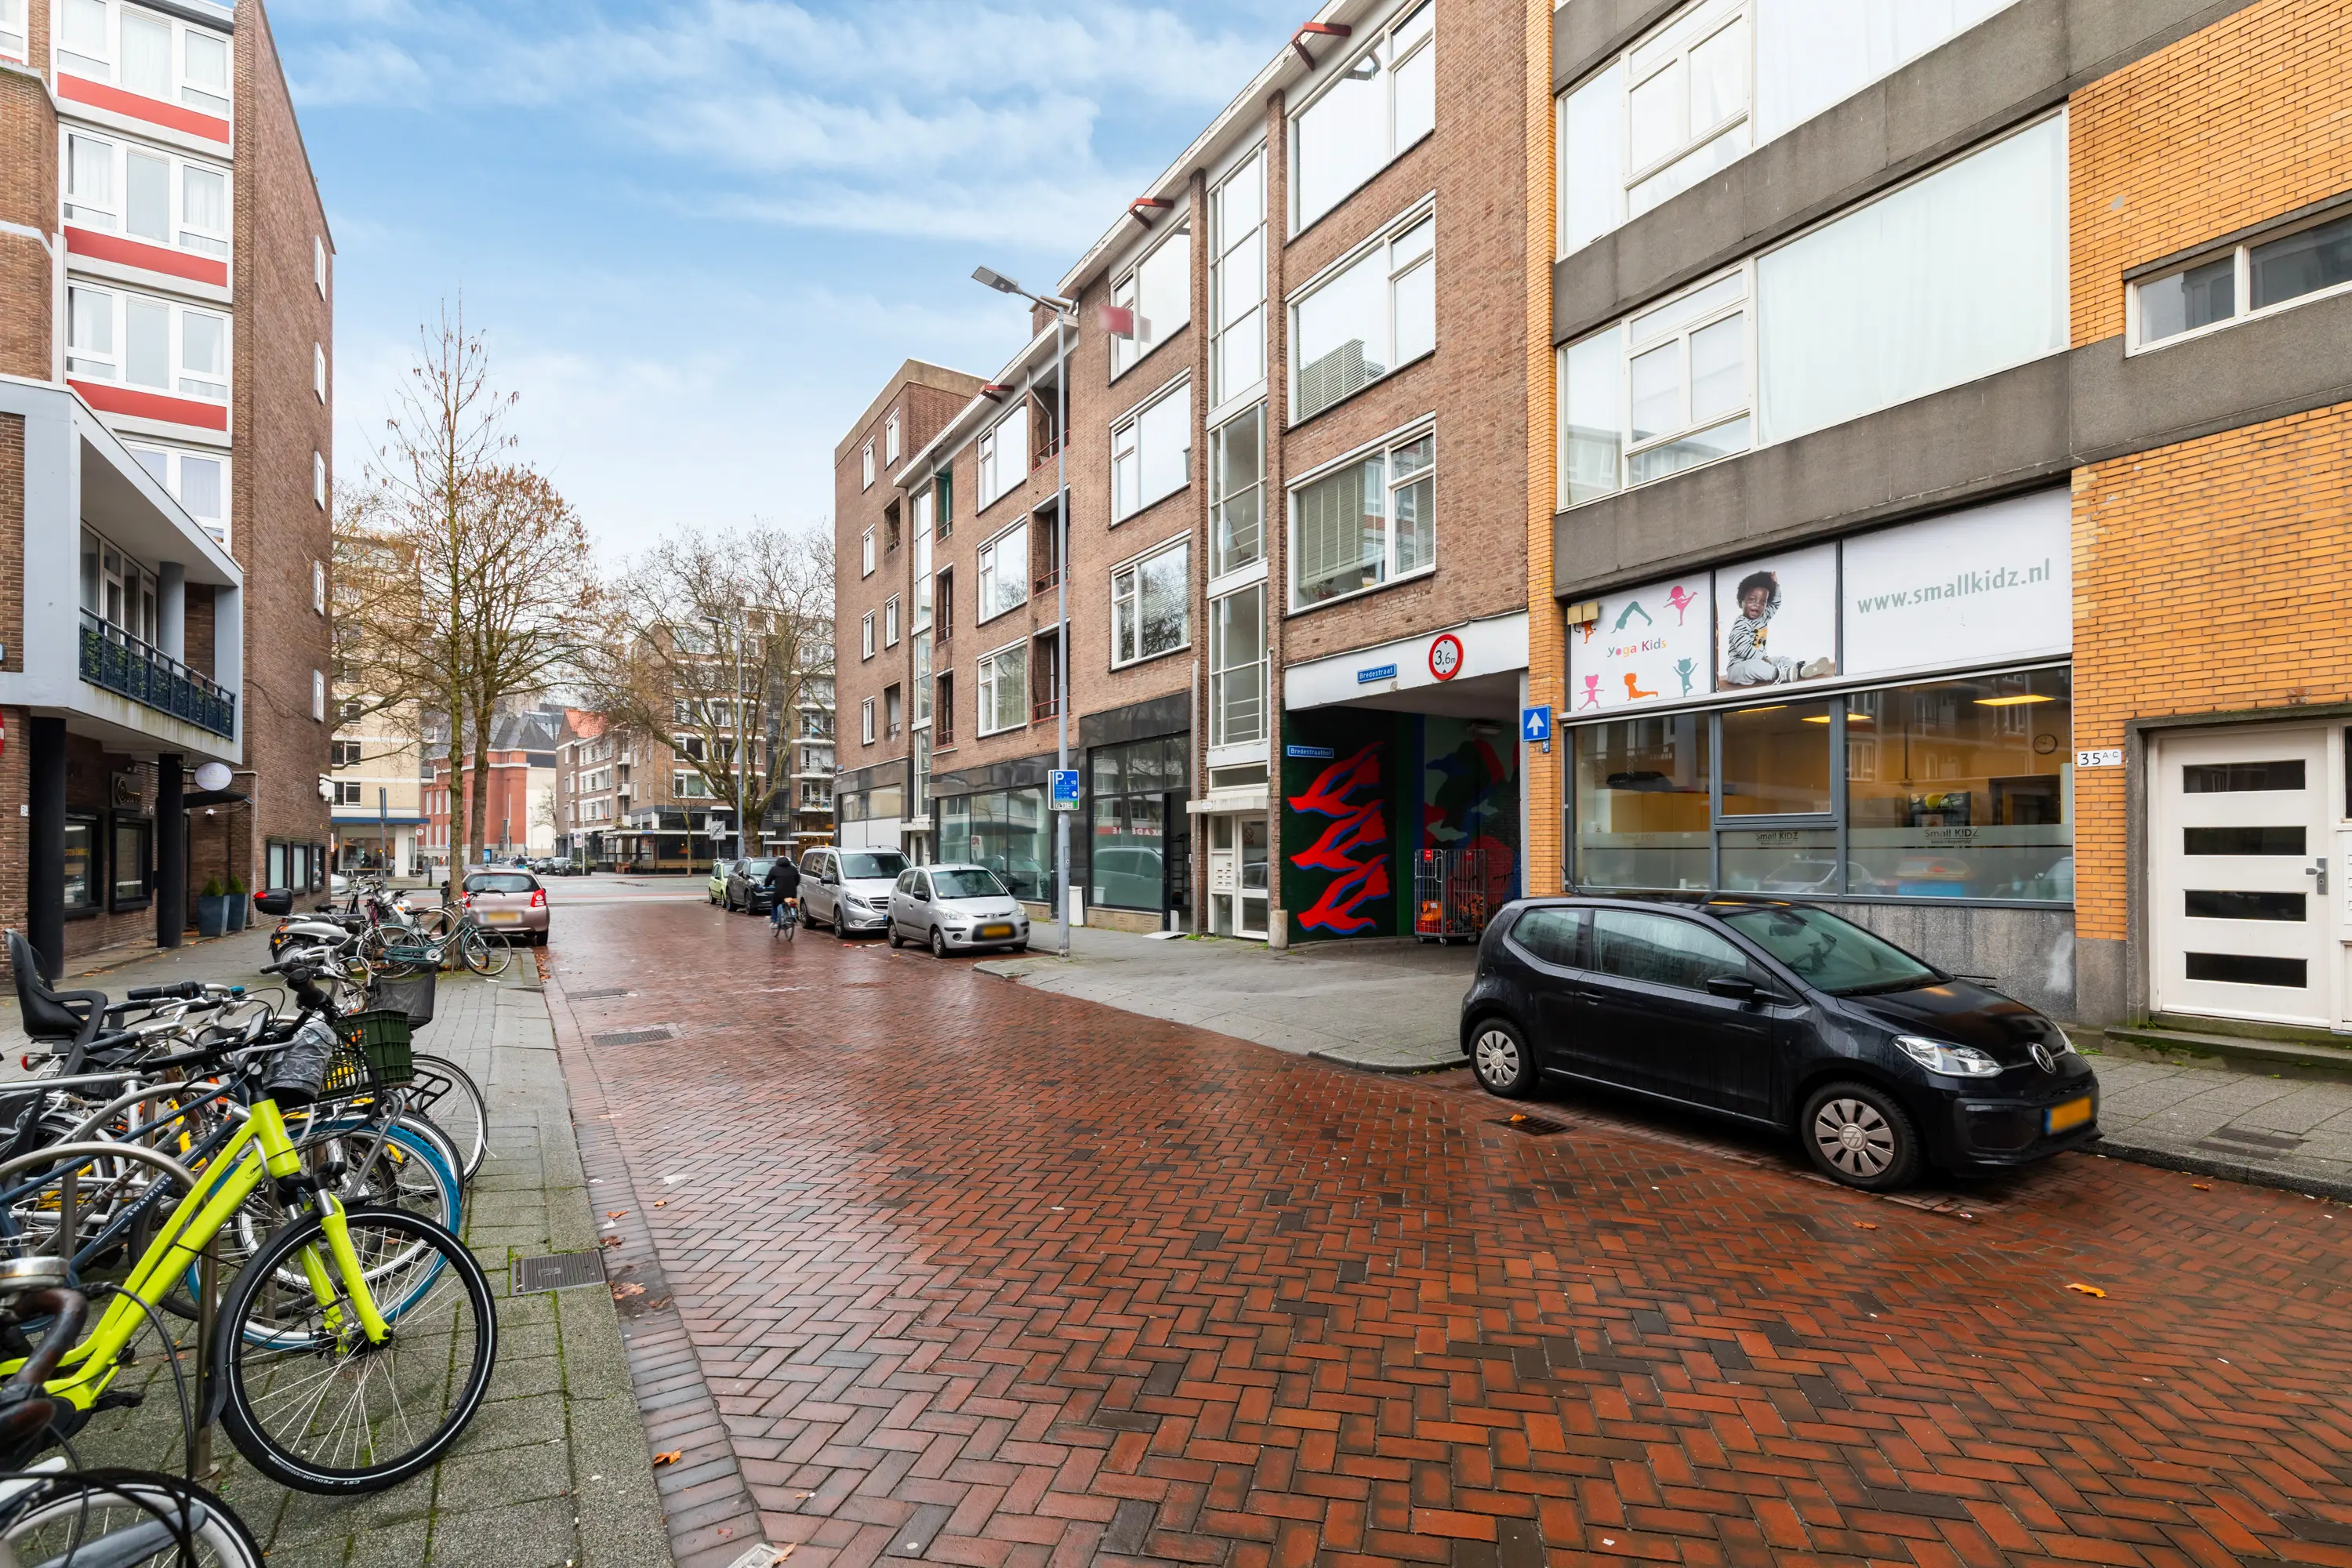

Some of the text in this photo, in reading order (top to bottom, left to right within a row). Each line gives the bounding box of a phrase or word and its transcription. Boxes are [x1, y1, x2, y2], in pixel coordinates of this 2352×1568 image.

[1857, 557, 2050, 614] www.smallkidz.nl
[1642, 637, 1667, 652] Kids
[1359, 666, 1393, 680] Bredestraat
[1290, 747, 1331, 756] Bredestraathof
[1055, 771, 1065, 785] P
[1756, 832, 1777, 840] Small
[1924, 828, 1980, 838] Small KIDZ
[126, 1176, 172, 1217] SWAPFIETS
